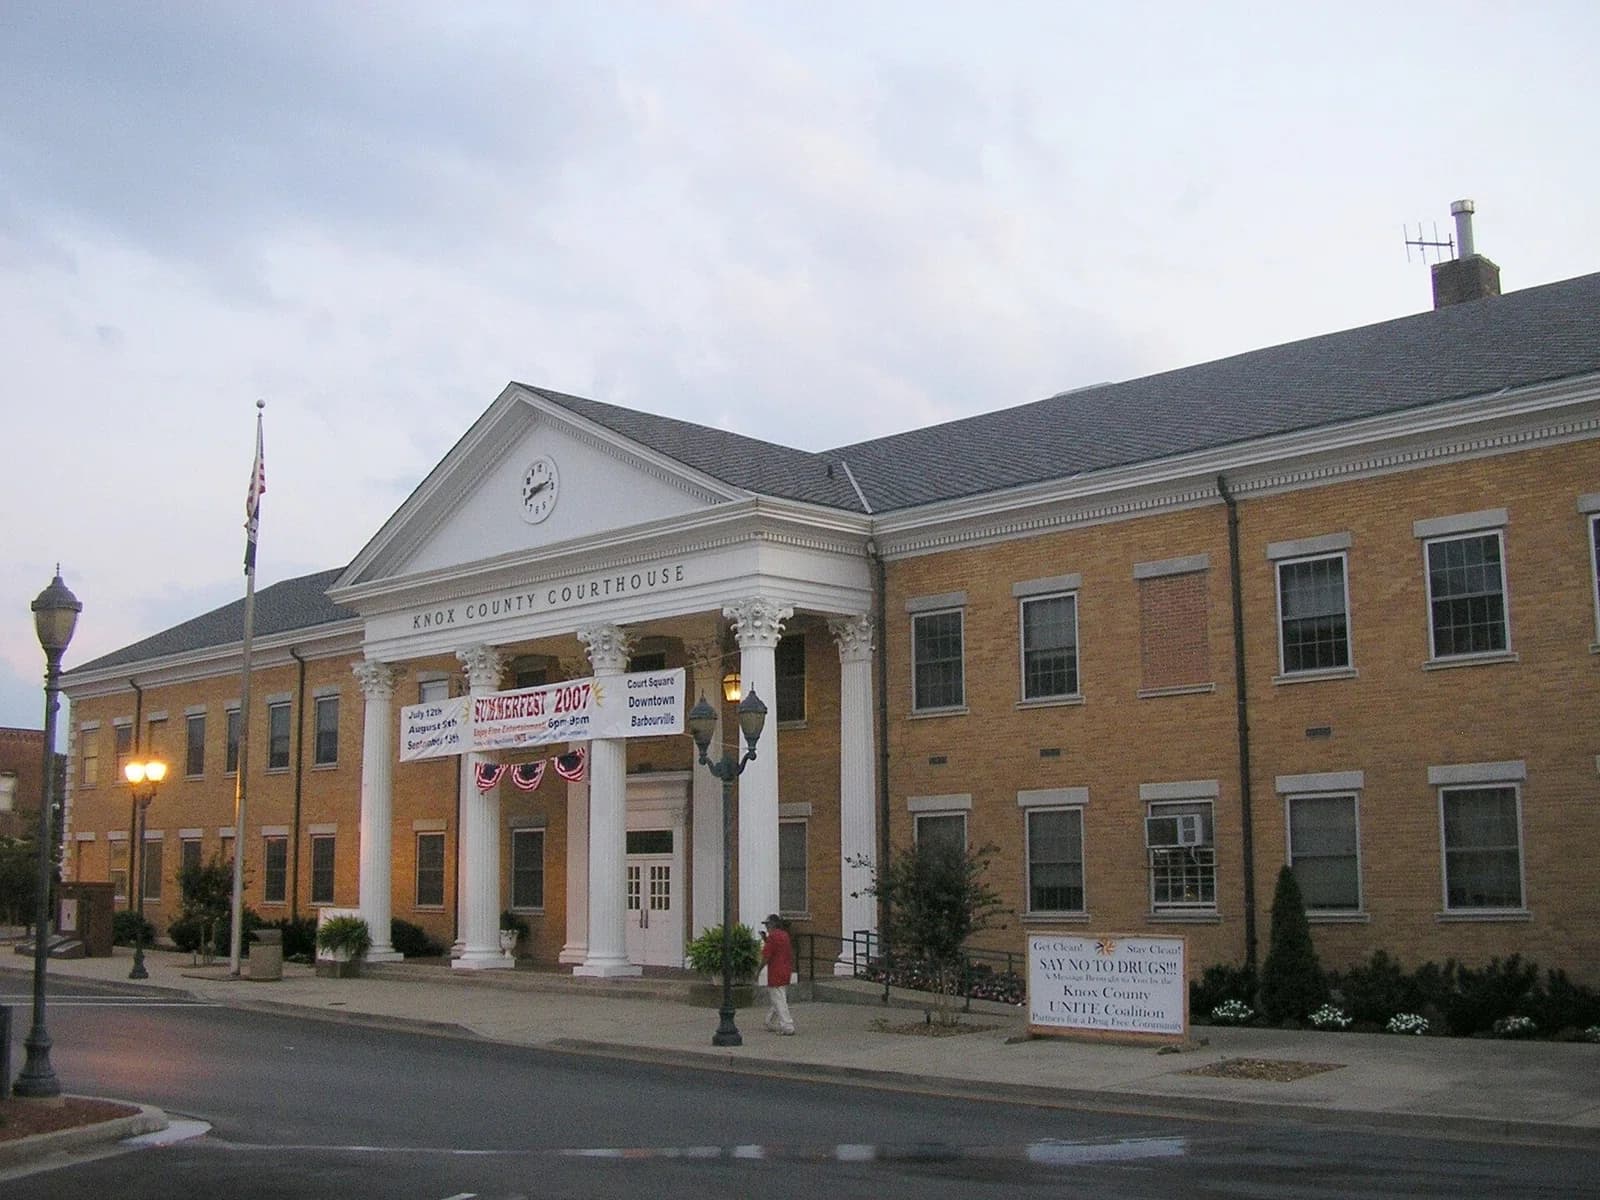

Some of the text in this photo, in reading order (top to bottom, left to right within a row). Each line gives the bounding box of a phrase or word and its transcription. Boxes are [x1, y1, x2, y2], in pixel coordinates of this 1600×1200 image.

[413, 565, 685, 629] KNOX COUNTY COURTHOUSE
[627, 677, 675, 689] Court Square
[474, 684, 590, 723] SUMMERFEST 2007
[628, 695, 675, 708] Downtown
[408, 707, 443, 720] July 12th
[631, 713, 675, 727] Barbourville
[408, 723, 441, 734] August
[1033, 941, 1050, 951] Get
[1040, 958, 1177, 975] SAY NO TO DRUGS!!!
[1064, 985, 1152, 1000] Knox County
[1049, 1001, 1165, 1019] UNITE Coalition
